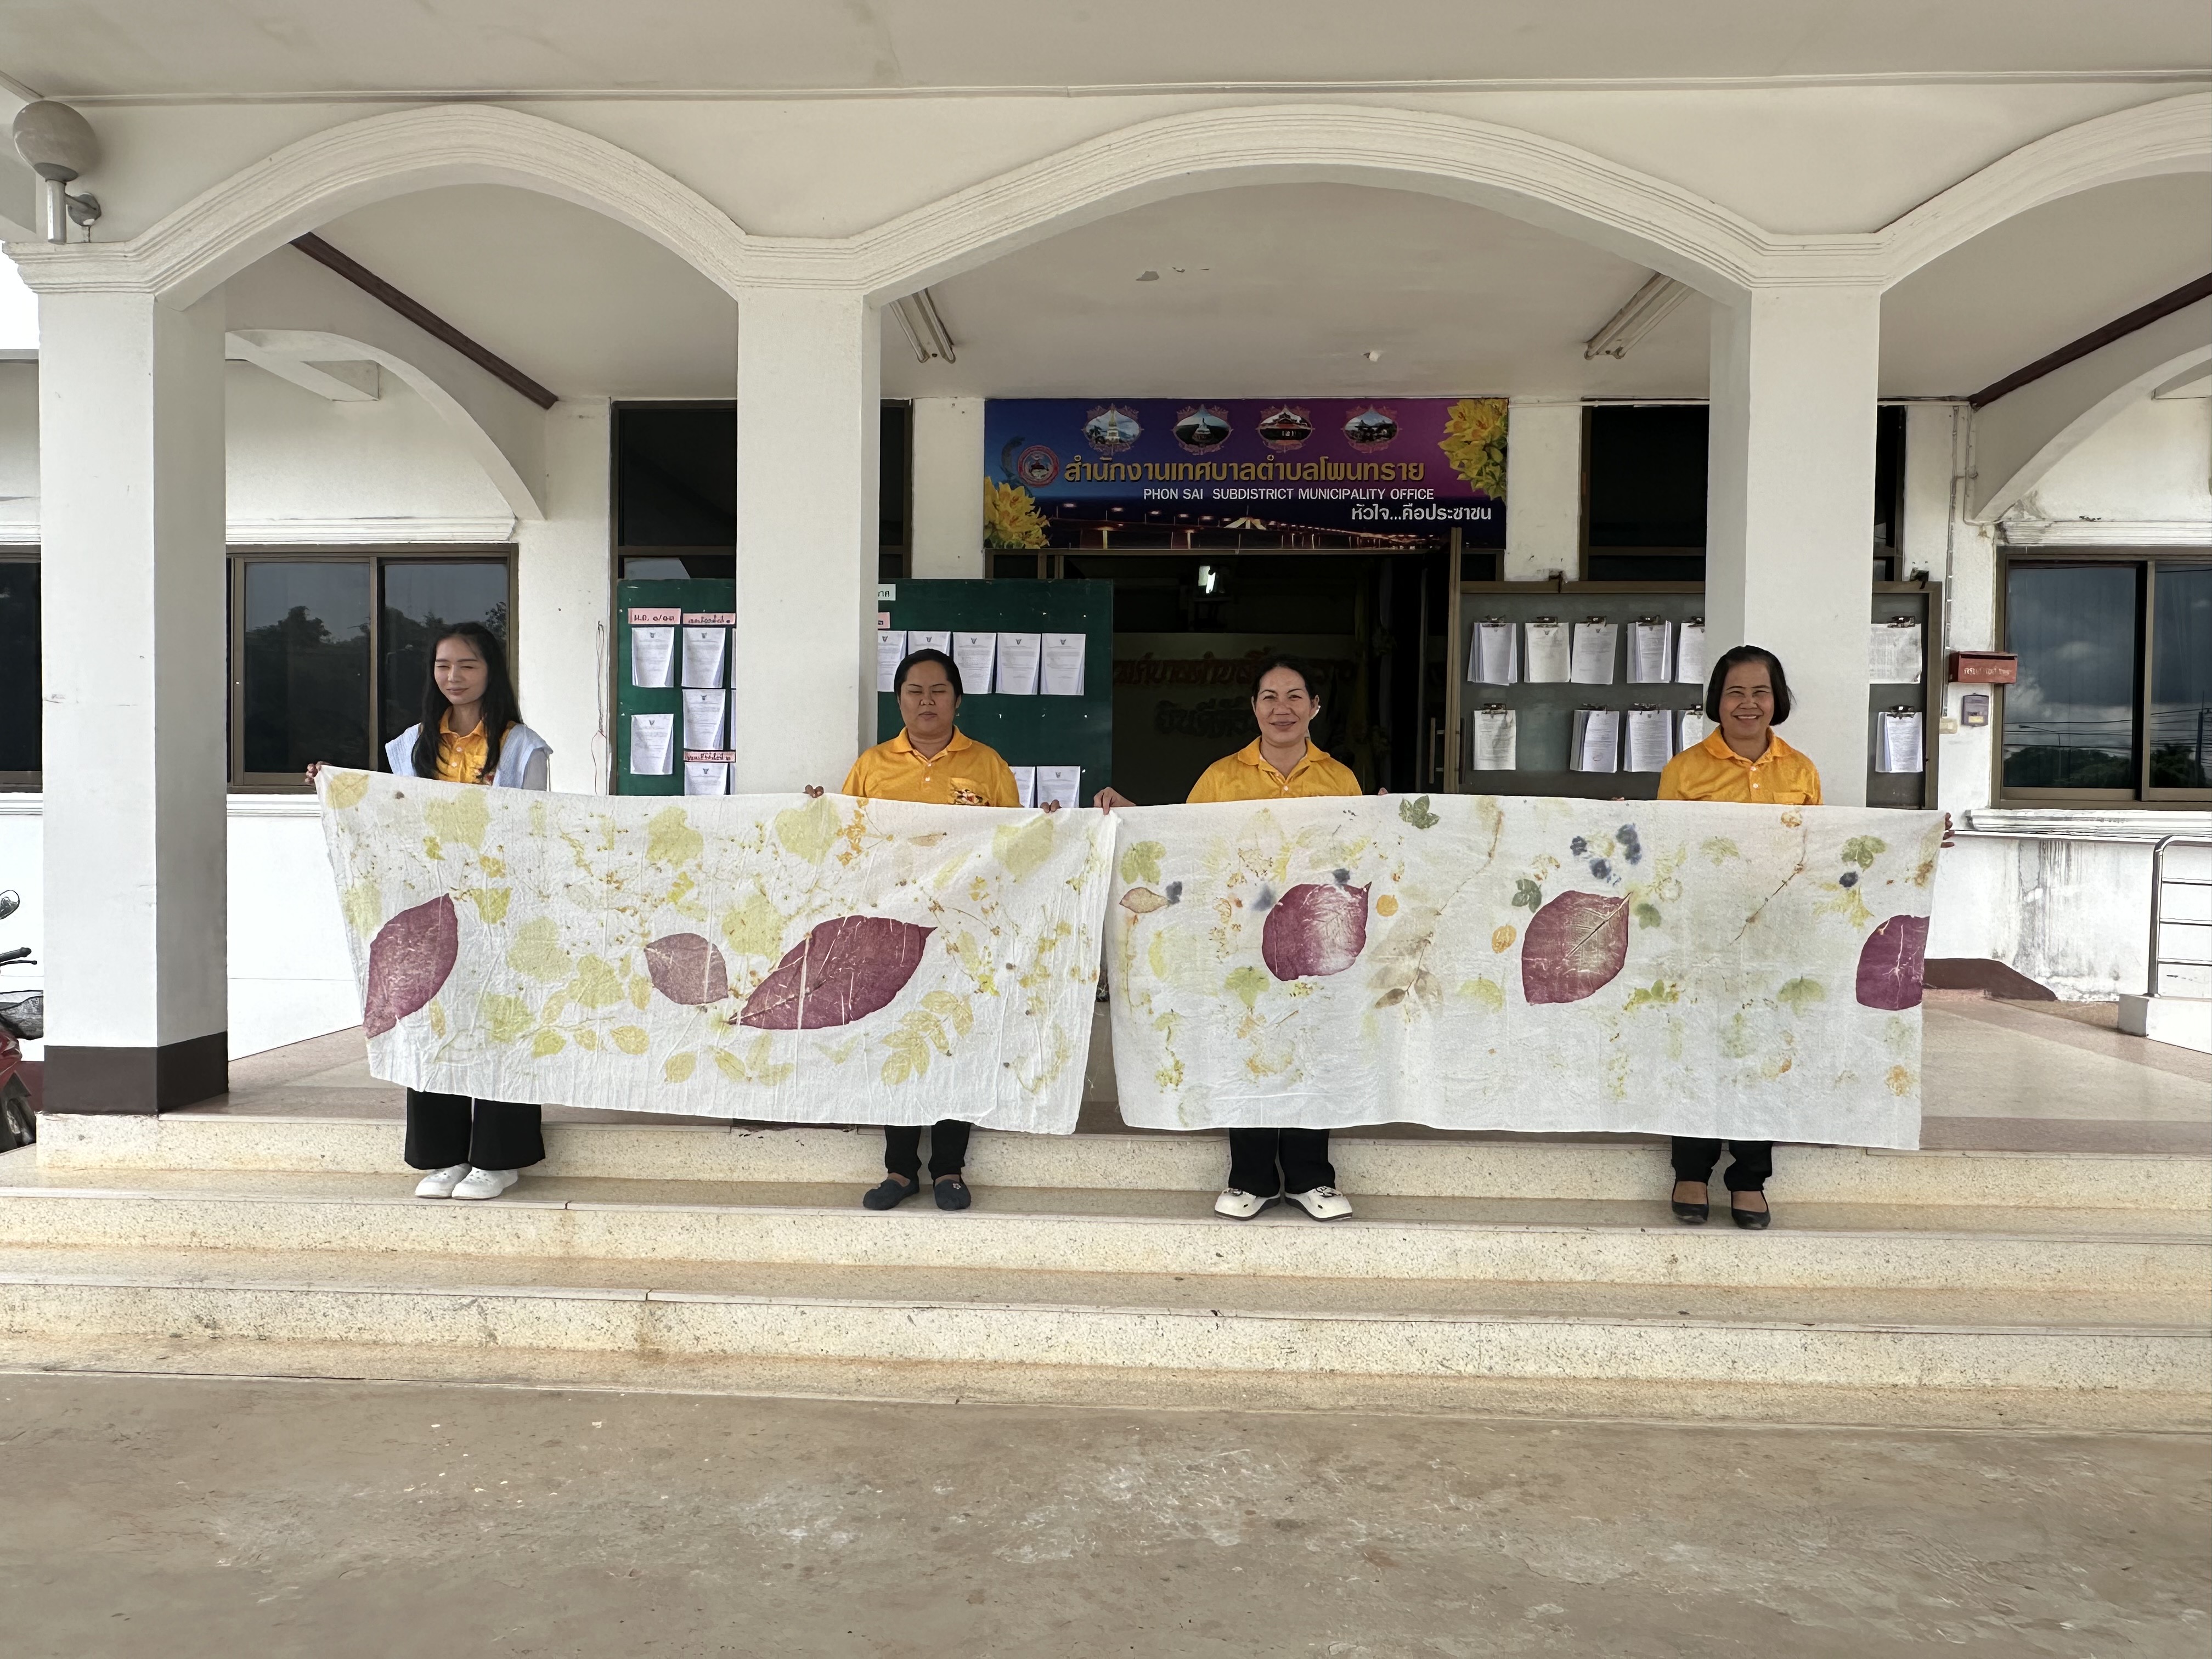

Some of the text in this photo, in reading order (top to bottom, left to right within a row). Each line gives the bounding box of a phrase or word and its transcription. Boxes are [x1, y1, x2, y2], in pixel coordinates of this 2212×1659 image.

[1064, 454, 1425, 482] สำนักงานเทศบาลตำบลโพนทราย
[1143, 488, 1434, 500] PHON SAI SUBDISTRICT MUNICIPALITY OFFICE
